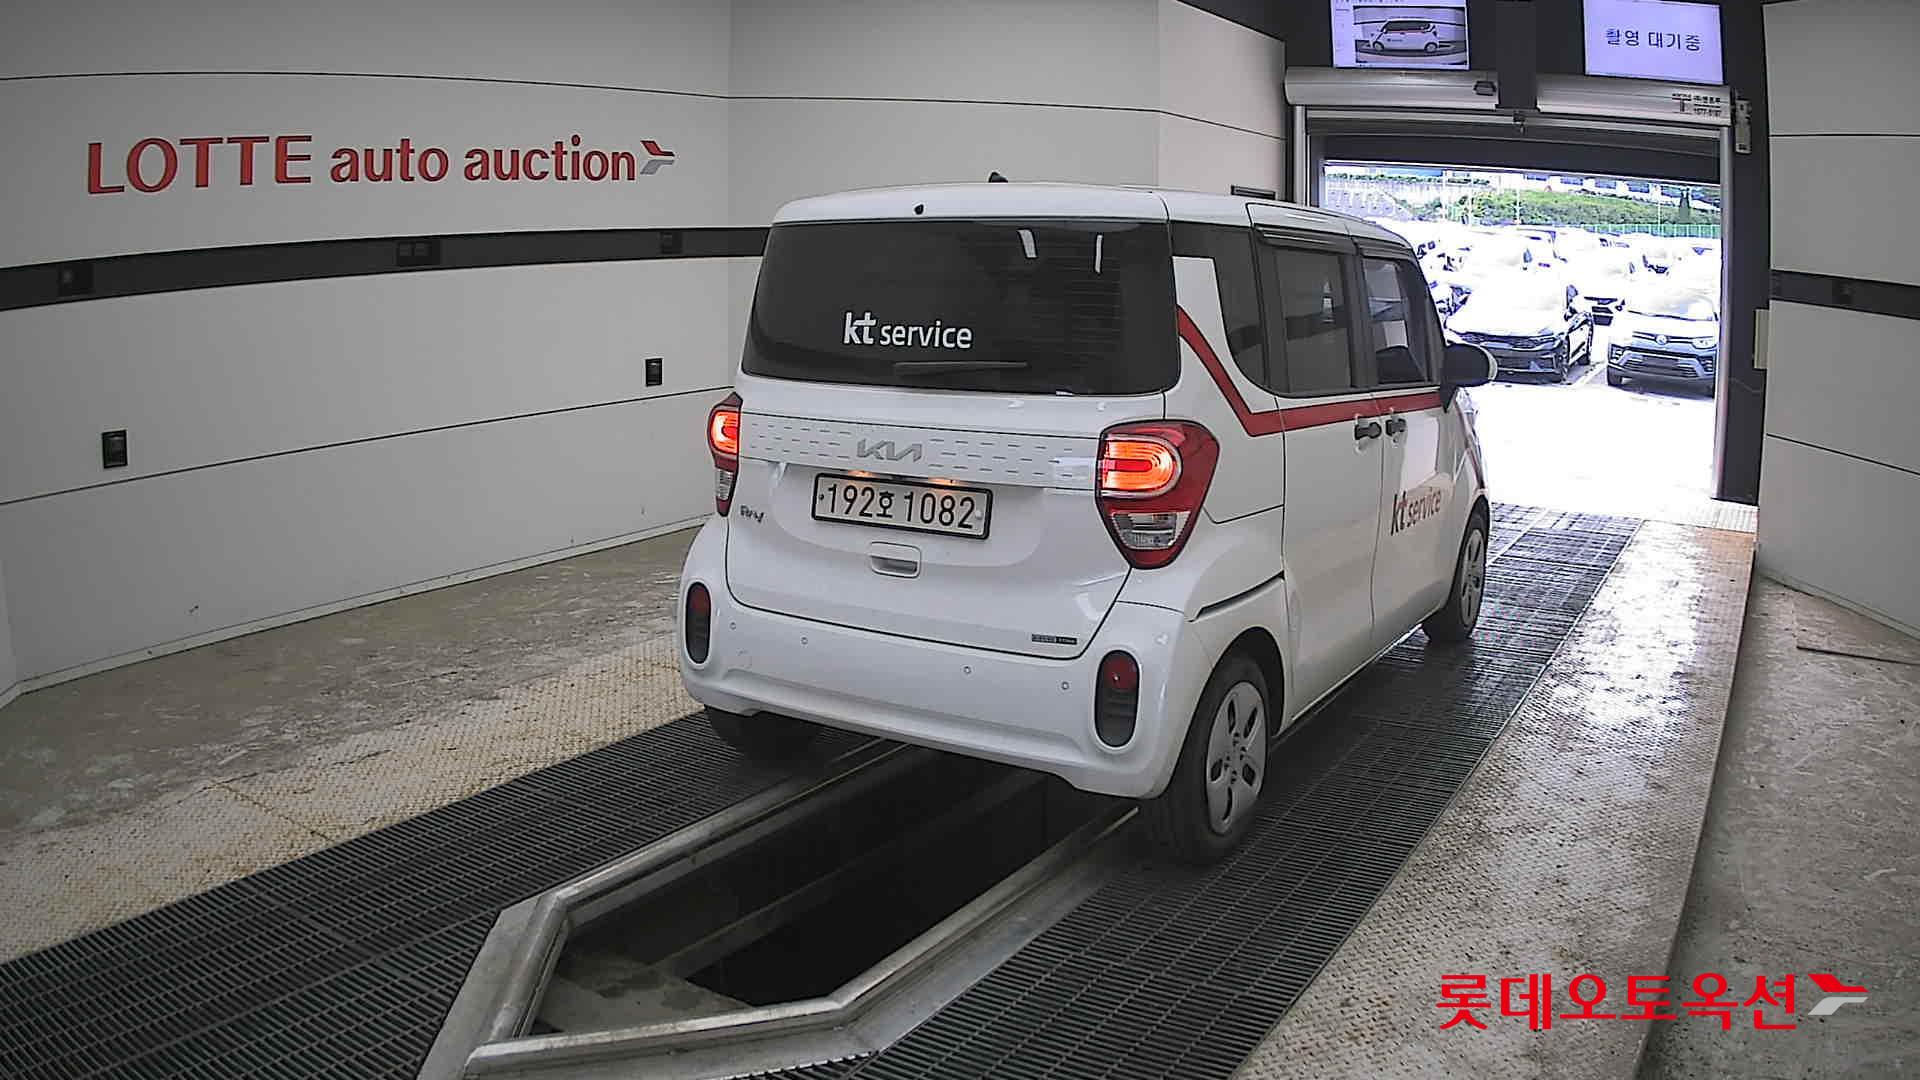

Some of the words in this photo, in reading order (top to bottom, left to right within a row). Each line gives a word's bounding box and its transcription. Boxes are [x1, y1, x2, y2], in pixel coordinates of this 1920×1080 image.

[86, 134, 312, 195] LOTTE
[329, 137, 449, 184] auto
[463, 133, 636, 182] auction
[843, 311, 877, 345] kt
[879, 320, 973, 349] service
[827, 483, 894, 518] 192호
[903, 490, 976, 530] 1082
[1390, 490, 1408, 536] kt
[1406, 486, 1442, 528] service
